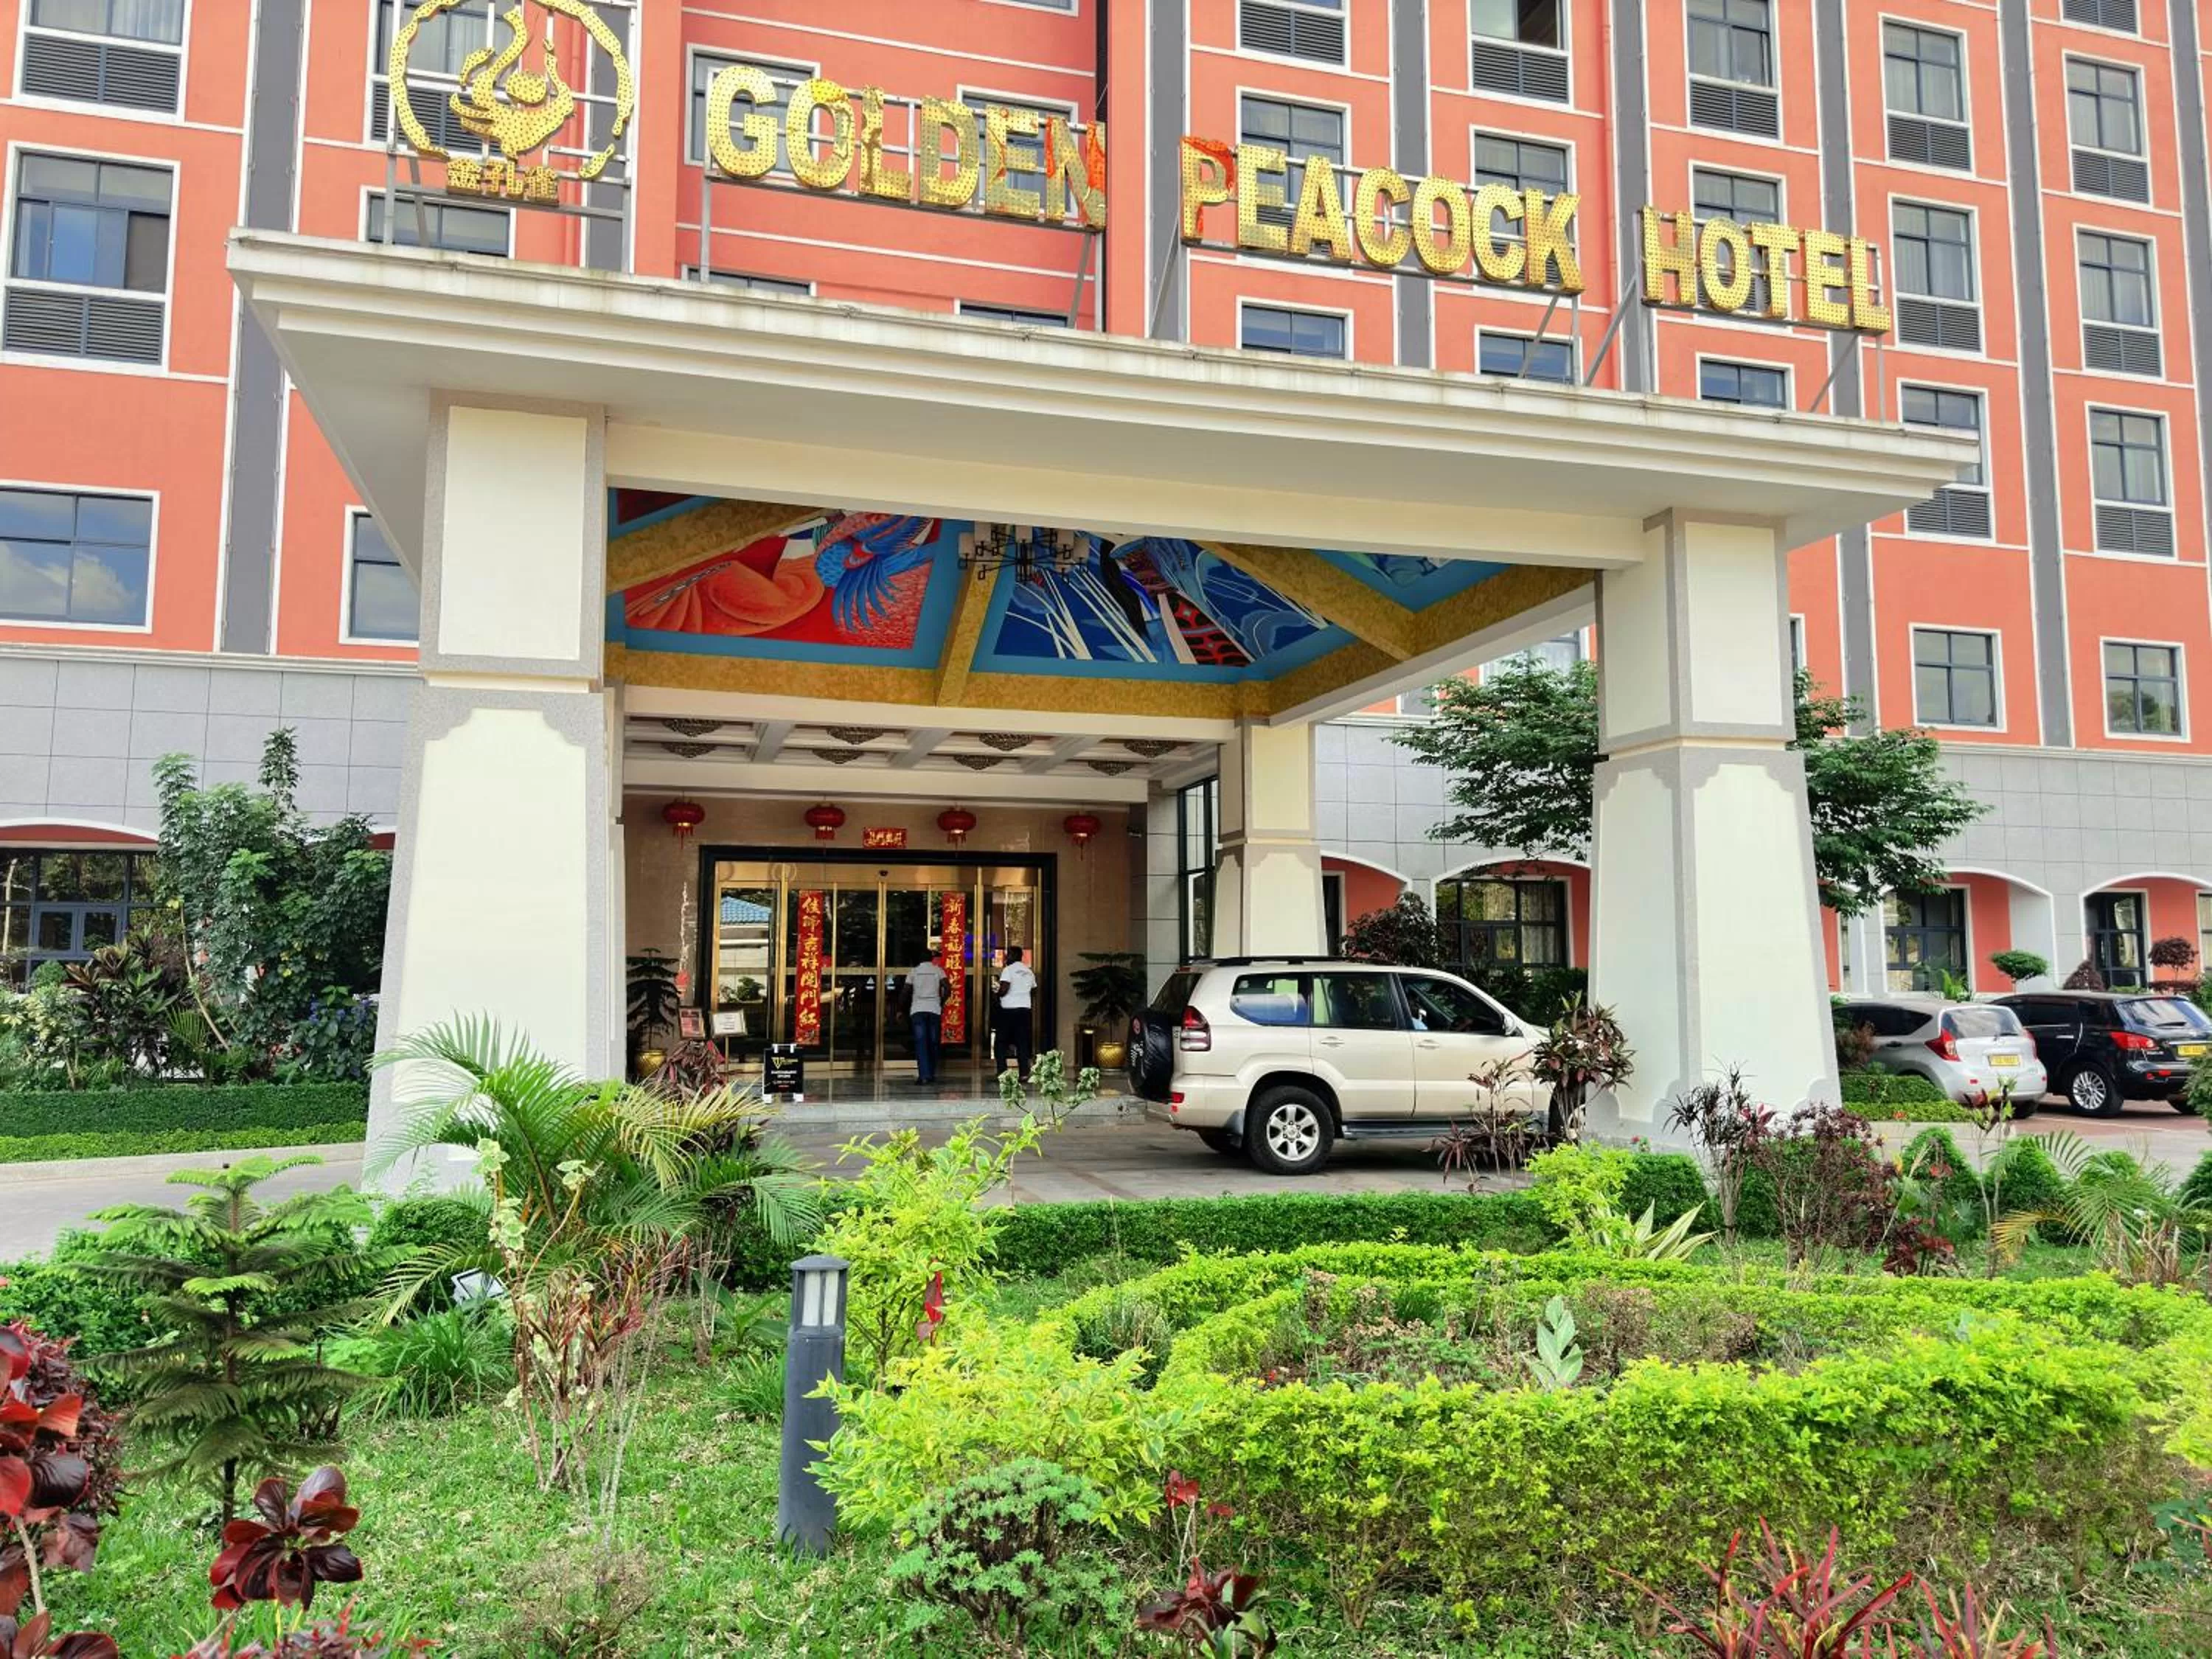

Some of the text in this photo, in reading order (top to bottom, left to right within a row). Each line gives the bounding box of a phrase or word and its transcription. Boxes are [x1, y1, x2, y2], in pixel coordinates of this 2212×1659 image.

[447, 156, 560, 204] 金孔雀
[706, 64, 1892, 333] GOLDEN PEACOCK HOTEL
